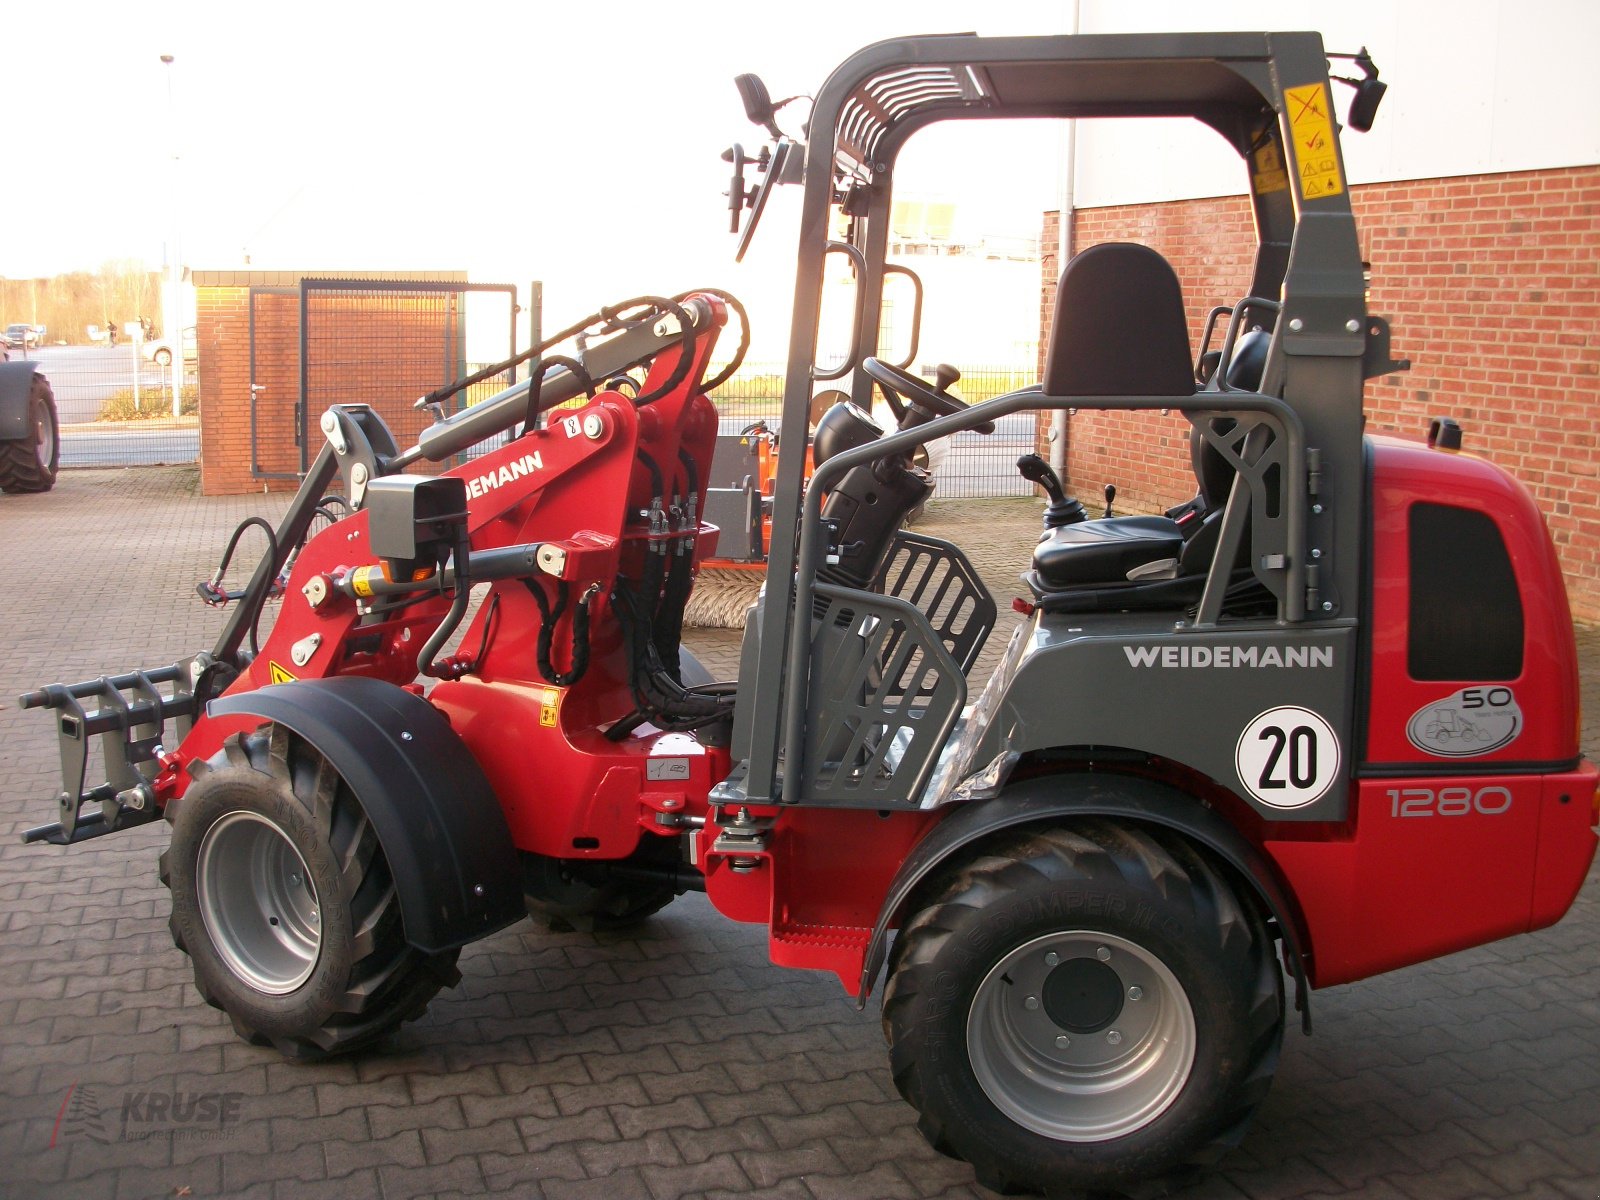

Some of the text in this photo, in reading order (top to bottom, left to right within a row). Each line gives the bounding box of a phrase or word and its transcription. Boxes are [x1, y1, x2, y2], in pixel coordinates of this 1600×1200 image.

[1123, 646, 1333, 668] WEIDEMANN
[1462, 688, 1512, 708] 50
[1258, 725, 1318, 789] 20
[1386, 786, 1512, 818] 1280
[990, 889, 1128, 934] DUMPER
